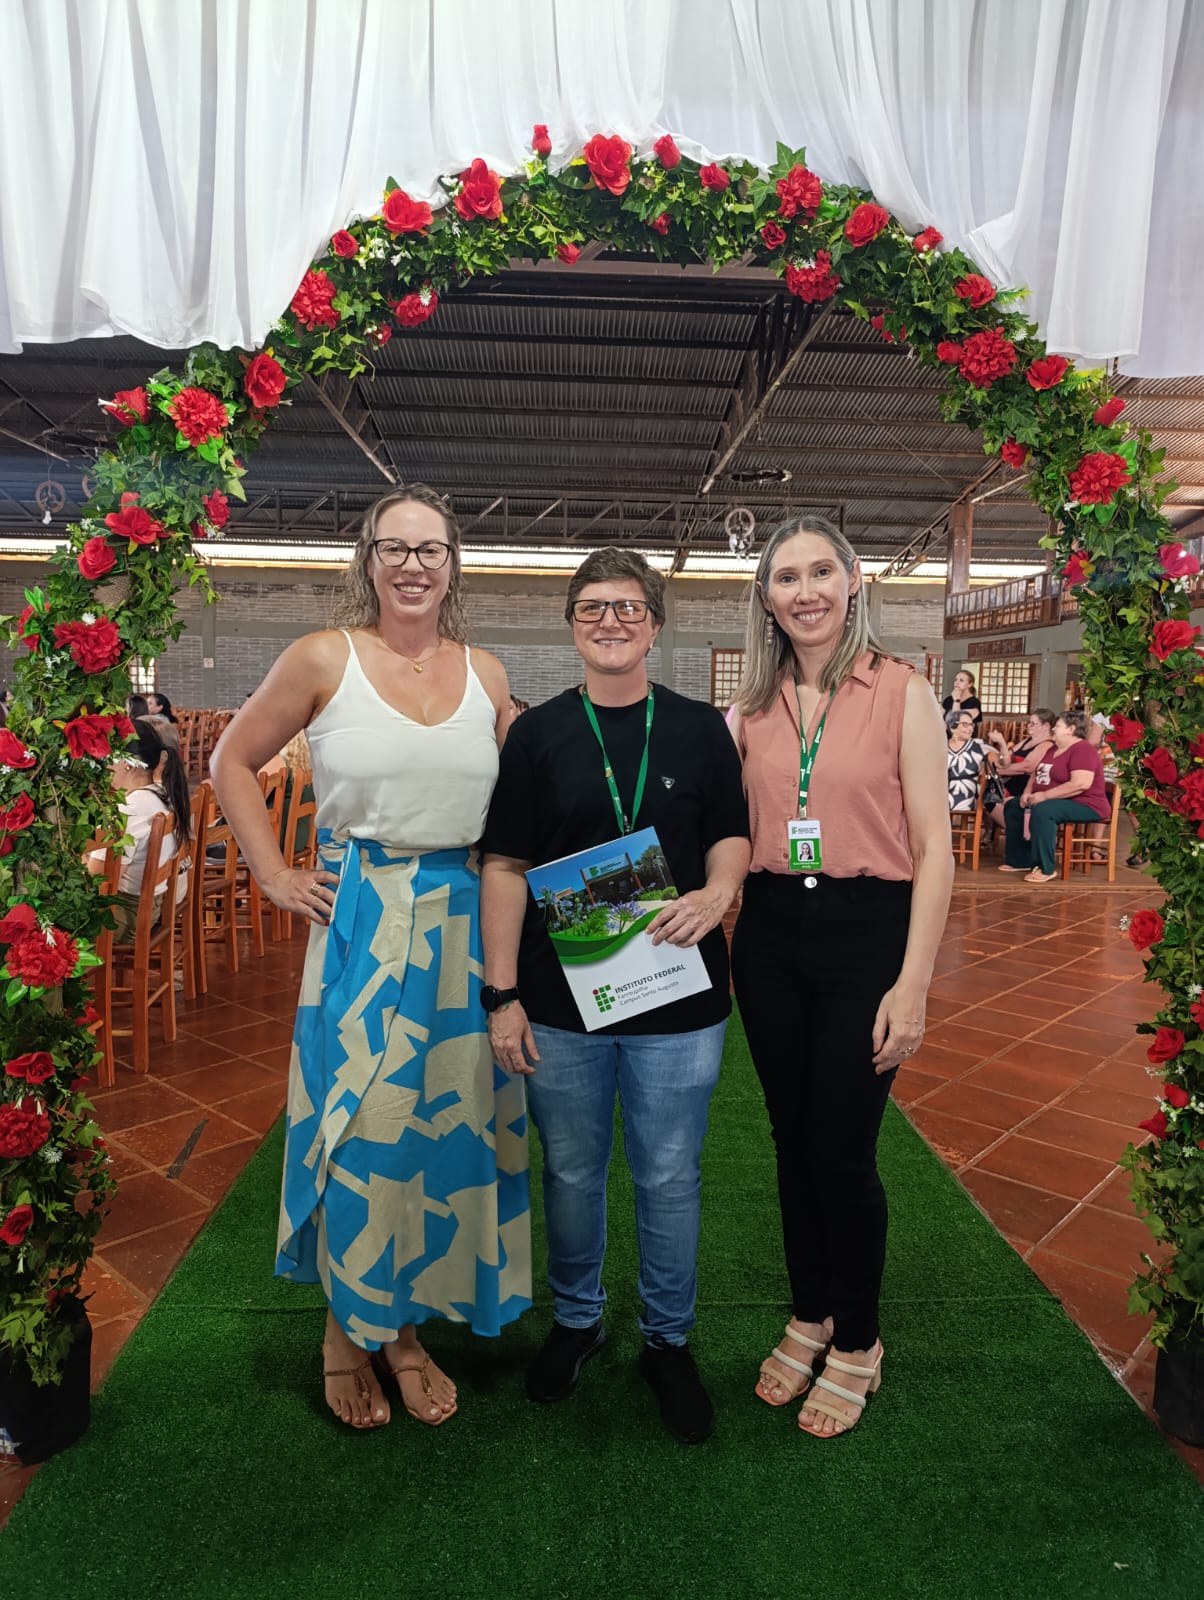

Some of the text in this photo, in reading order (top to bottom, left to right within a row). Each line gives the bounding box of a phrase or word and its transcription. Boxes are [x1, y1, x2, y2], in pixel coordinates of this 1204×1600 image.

[615, 964, 686, 993] INSTITUTO FEDERAL
[620, 995, 641, 1006] Campus
